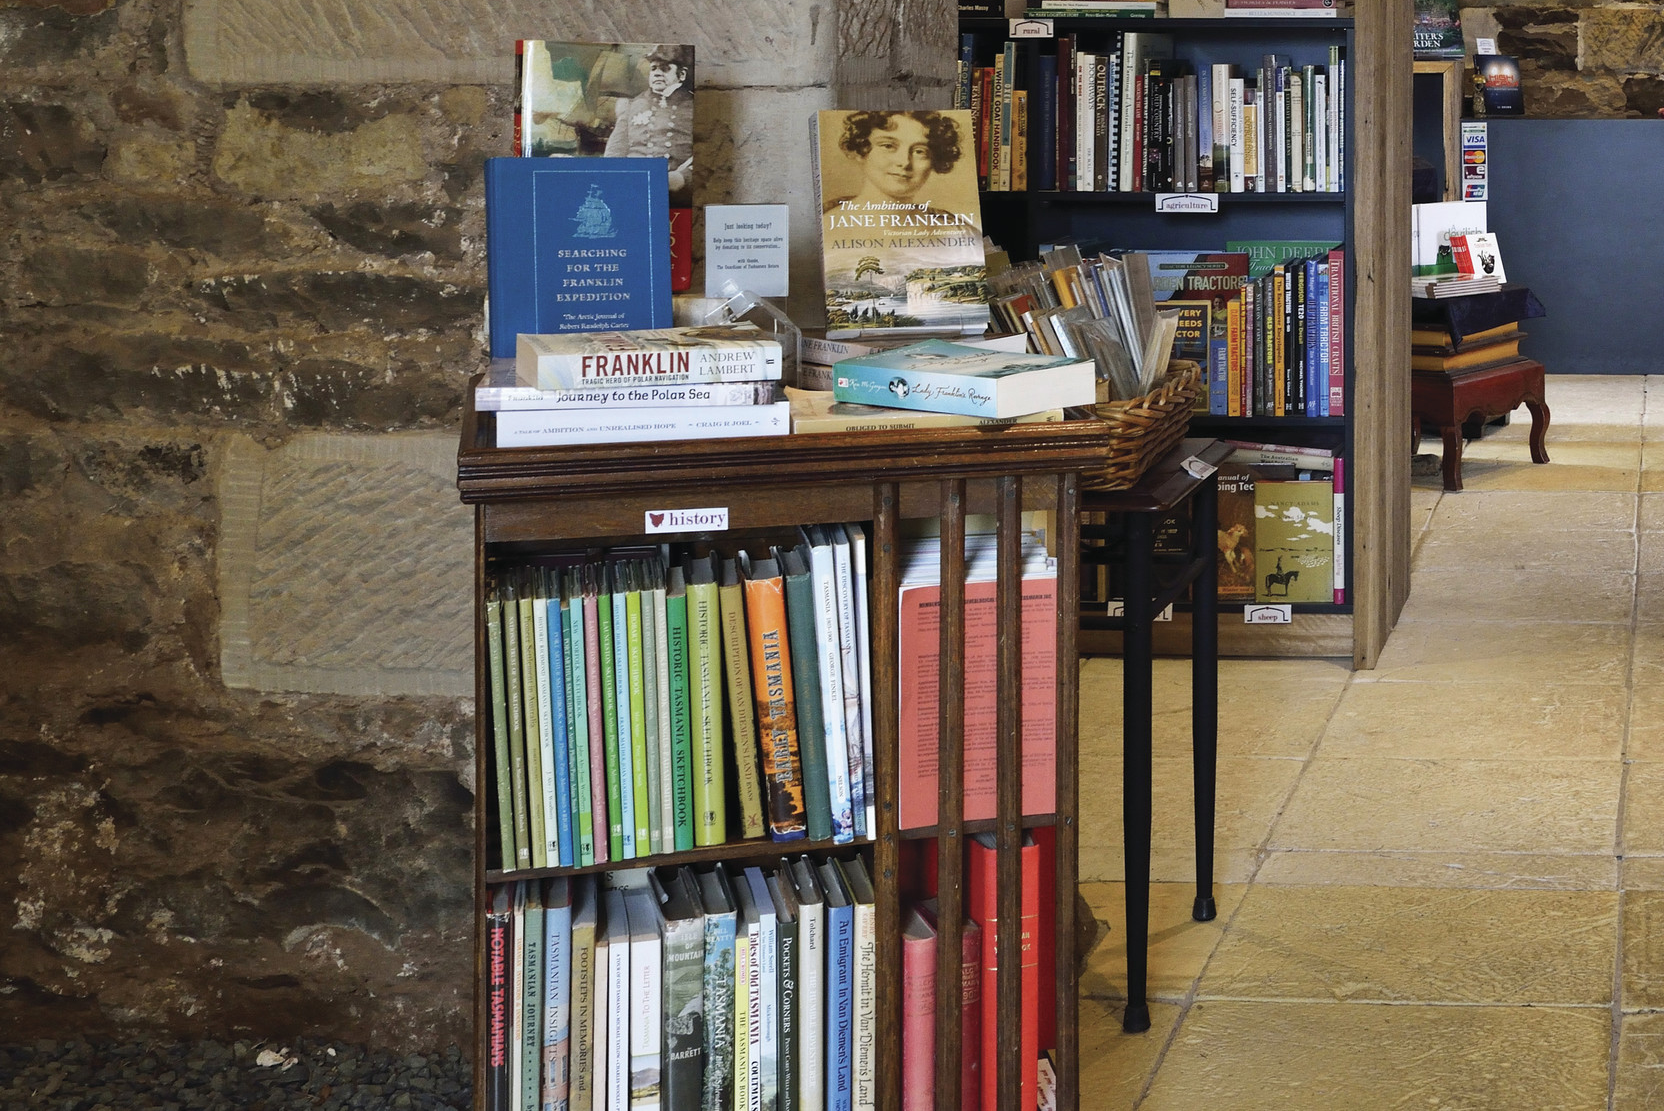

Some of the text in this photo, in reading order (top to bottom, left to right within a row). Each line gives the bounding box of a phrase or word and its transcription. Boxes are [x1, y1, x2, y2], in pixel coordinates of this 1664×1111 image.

[1022, 27, 1041, 36] rural
[1003, 83, 1011, 104] OXEN
[1097, 64, 1106, 110] OUTBACK
[1466, 135, 1485, 143] VISA
[992, 123, 1000, 170] HANDBOOK
[838, 199, 932, 213] The Ambitions of
[1165, 201, 1208, 211] agriculture
[724, 222, 772, 231] Just looking today?
[830, 212, 975, 230] JANE FRANKLIN
[831, 236, 976, 249] ALISON ALEXANDER
[557, 248, 628, 259] SEARCHING
[1236, 246, 1277, 258] JOHN
[566, 262, 620, 273] FOR THE
[562, 276, 624, 288] FRANKLIN
[556, 291, 631, 303] EXPEDITION
[1331, 261, 1341, 374] TRADITIONAL BRITISH CRAFTS
[1320, 301, 1329, 363] FARM TRACTOR
[581, 351, 691, 378] FRANKLIN
[698, 352, 755, 363] ANDREW
[699, 364, 756, 376] LAMBERT
[605, 377, 621, 385] HERO
[654, 374, 690, 382] NAVIGATION
[556, 390, 608, 404] Journey
[612, 390, 626, 401] to
[628, 389, 649, 401] the
[652, 388, 686, 401] Polar
[688, 388, 711, 400] Sea
[912, 384, 934, 398] Lady
[541, 426, 584, 434] AMBITION
[599, 423, 653, 432] UNREALISED
[845, 423, 915, 432] OBLIGED TO SUBMIT
[668, 510, 726, 531] history
[1258, 613, 1278, 622] sheep
[699, 601, 713, 786] HISTORIC TASMANIA SKETCHBOOK
[762, 628, 793, 783] EARLY TASMANIA
[673, 626, 687, 828] HISTORIC TASMANIA SKETCHBOOK
[490, 927, 505, 1067] NOTABLE TASMANIANS
[527, 942, 536, 1047] TASMANIAN JOURNEY
[548, 932, 561, 1063] TASMANIAN INSIGHTS
[578, 947, 589, 1091] FOOTSTEPS IN MEMORIES and
